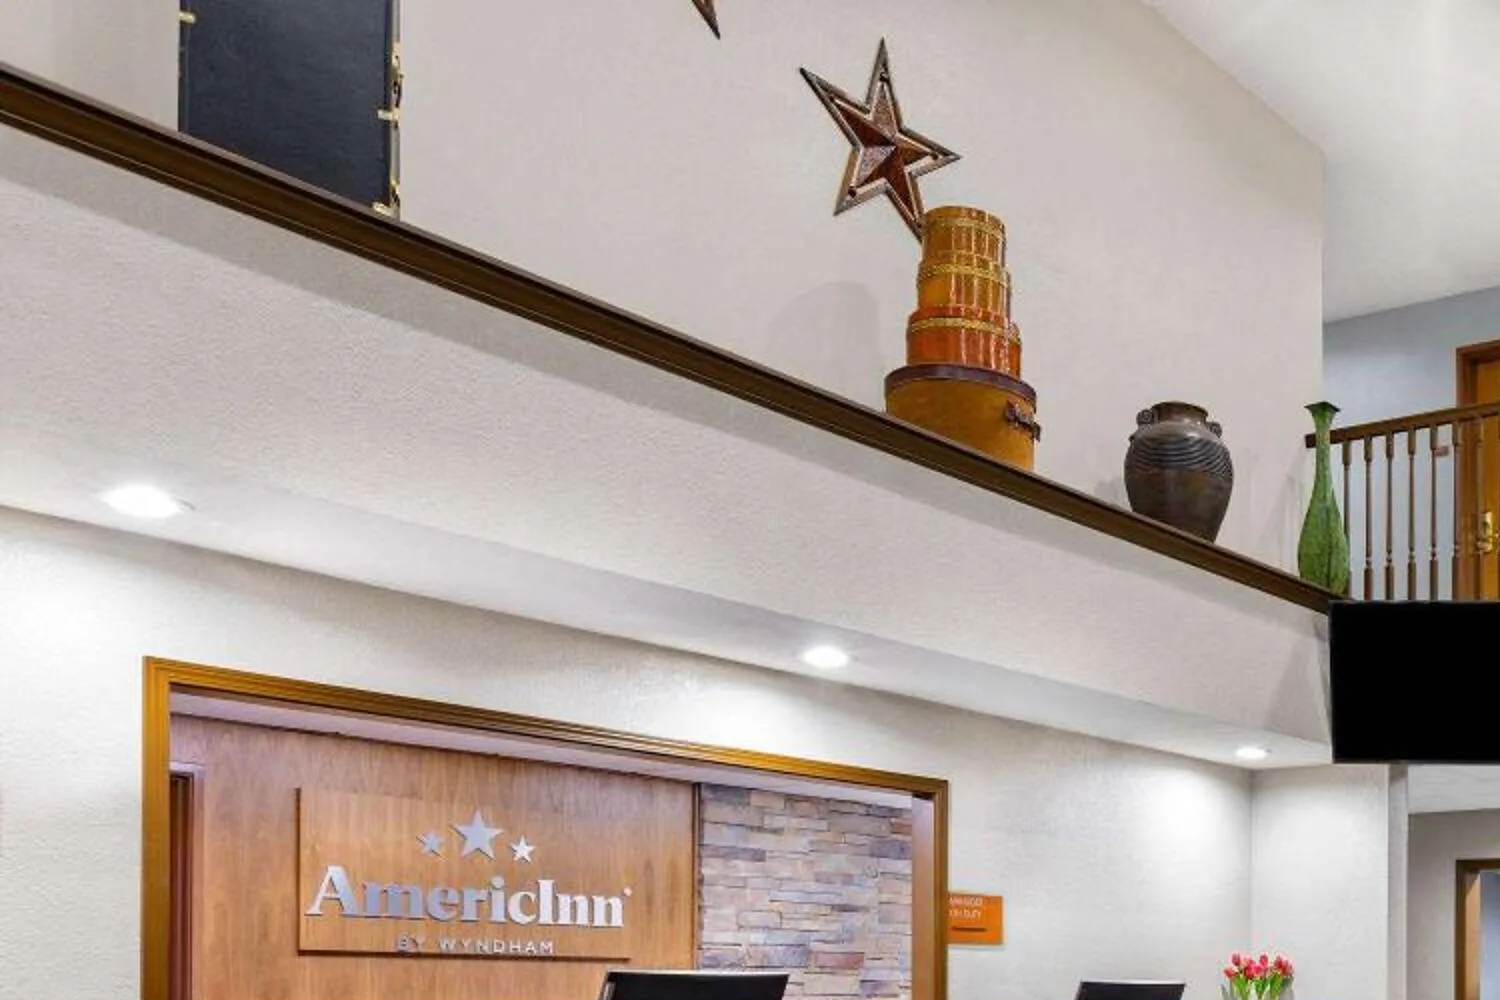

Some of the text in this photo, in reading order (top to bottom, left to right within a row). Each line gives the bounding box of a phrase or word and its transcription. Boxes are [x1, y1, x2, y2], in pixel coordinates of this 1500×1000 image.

[304, 864, 624, 928] AmericInn
[398, 934, 554, 955] BY WYNDHAM
